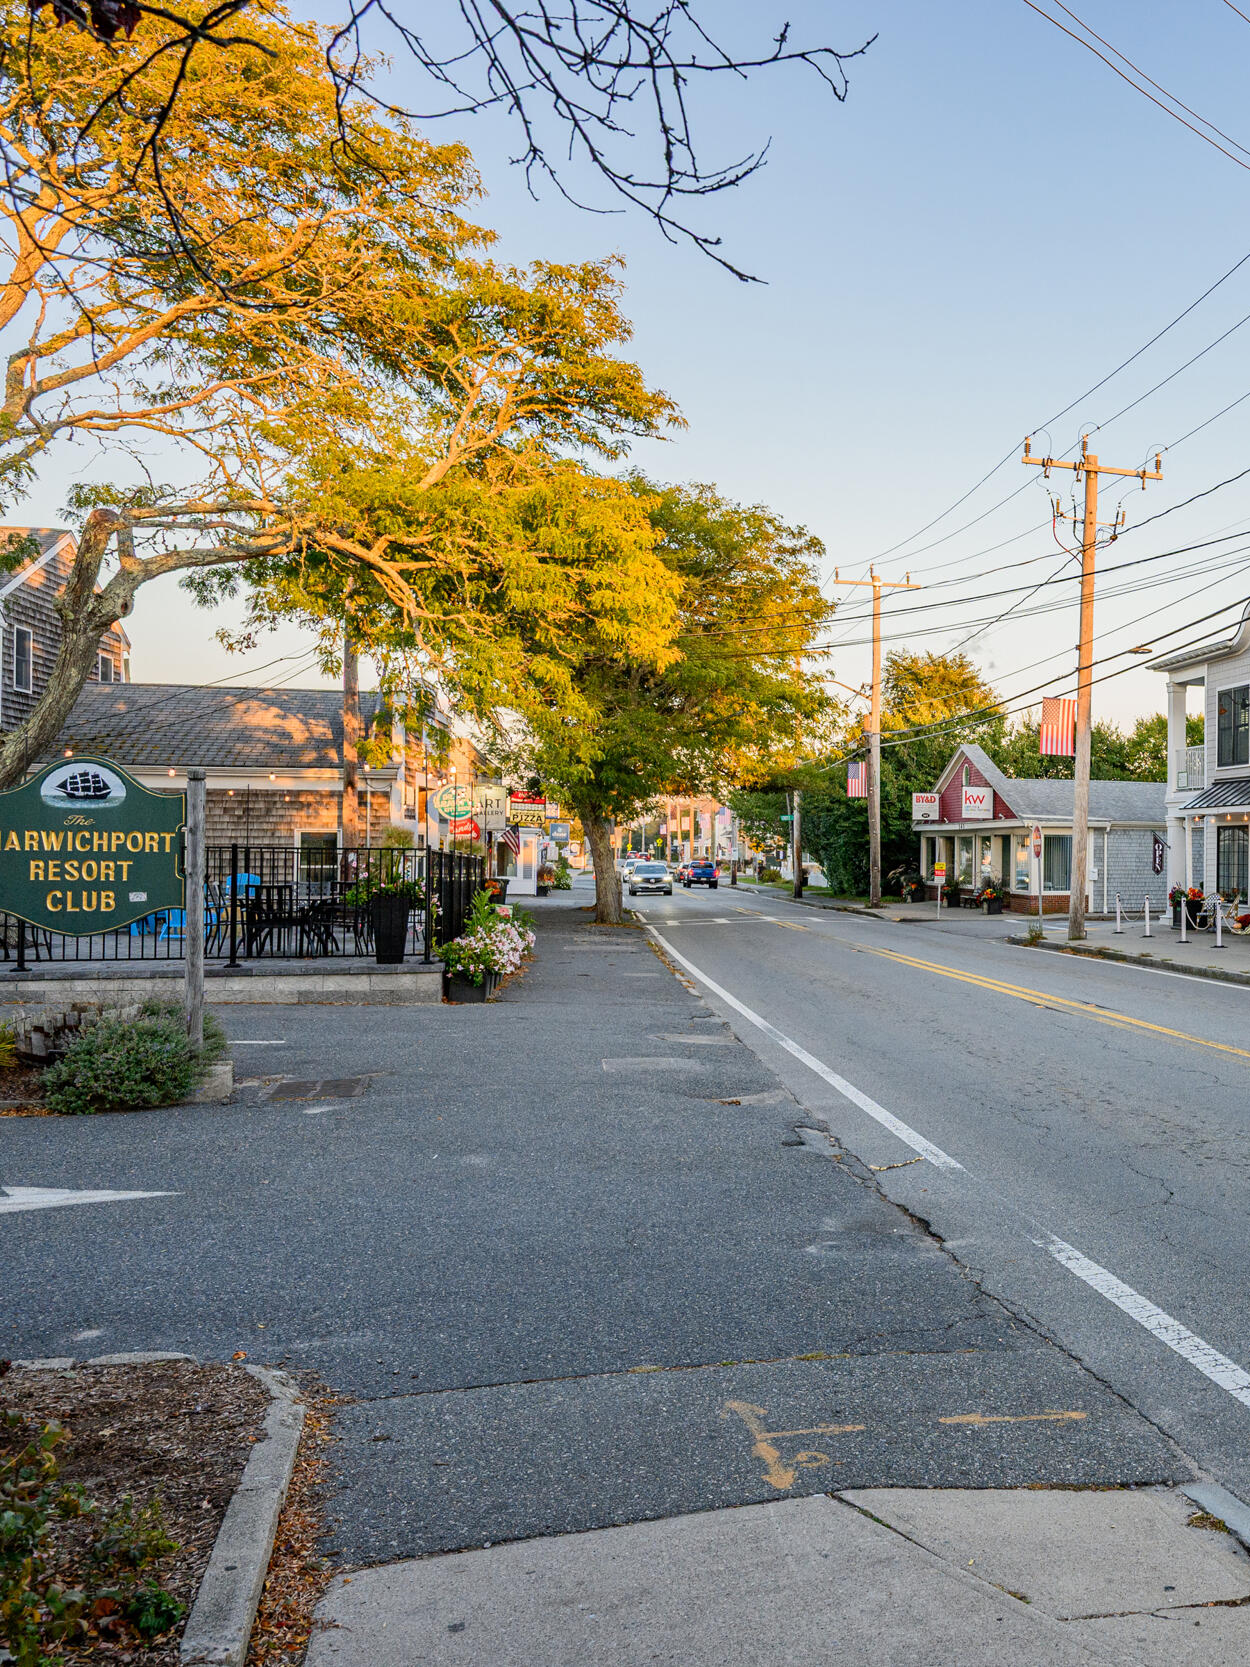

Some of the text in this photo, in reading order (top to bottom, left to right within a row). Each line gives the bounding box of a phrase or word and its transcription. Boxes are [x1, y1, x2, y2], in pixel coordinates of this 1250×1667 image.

[915, 795, 936, 804] BY&D
[63, 814, 96, 826] The
[512, 814, 543, 823] PIZZA
[0, 830, 176, 853] ARWICHPORT
[29, 859, 134, 882] RESORT
[46, 890, 116, 912] CLUB
